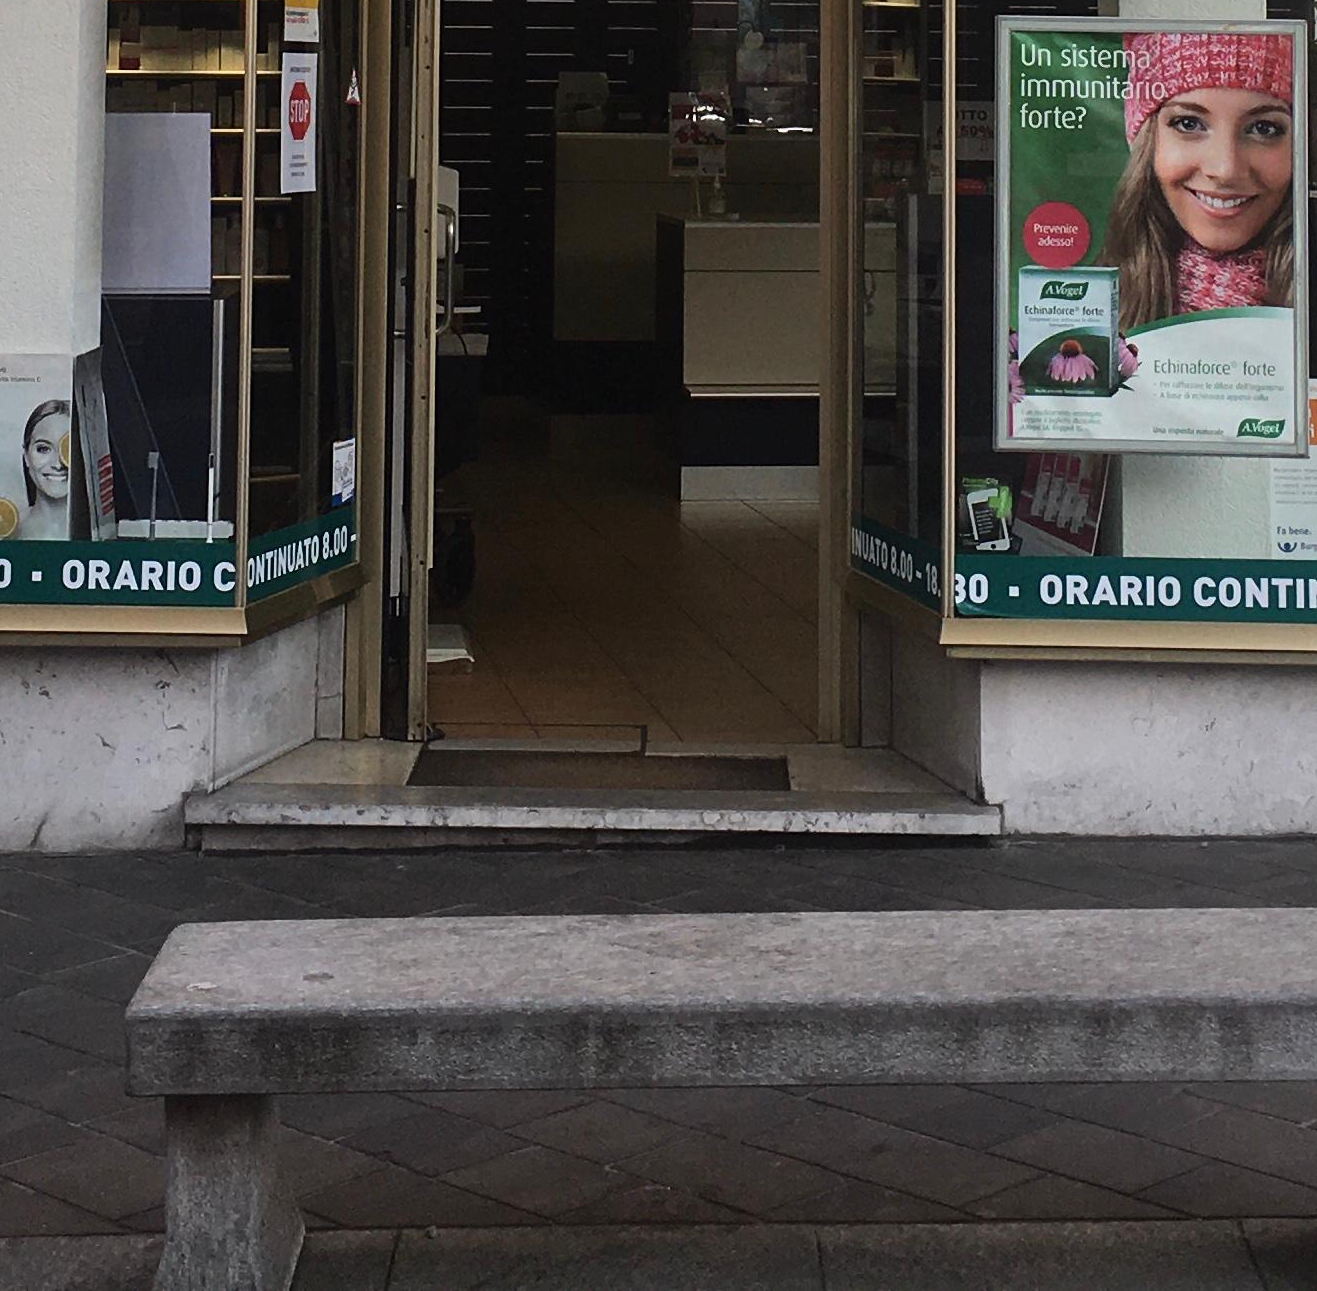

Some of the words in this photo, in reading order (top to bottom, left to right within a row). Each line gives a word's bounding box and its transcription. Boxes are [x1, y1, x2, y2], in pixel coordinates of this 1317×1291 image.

[1019, 43, 1052, 68] Un
[1059, 44, 1151, 69] sistema
[1019, 75, 1167, 100] immunitario
[289, 99, 310, 124] STOP
[1018, 104, 1087, 130] forte?
[1033, 223, 1079, 236] Prevenire
[1037, 234, 1075, 248] adesso!
[1045, 283, 1084, 297] A.Vogel
[1082, 306, 1105, 317] forte
[1243, 360, 1277, 377] forte
[1241, 421, 1281, 436] A.Vogel
[322, 525, 348, 560] 8.00
[1289, 525, 1312, 536] bene.
[62, 559, 202, 592] ORARIO
[890, 546, 913, 583] 8.00
[1039, 574, 1182, 607] ORARIO
